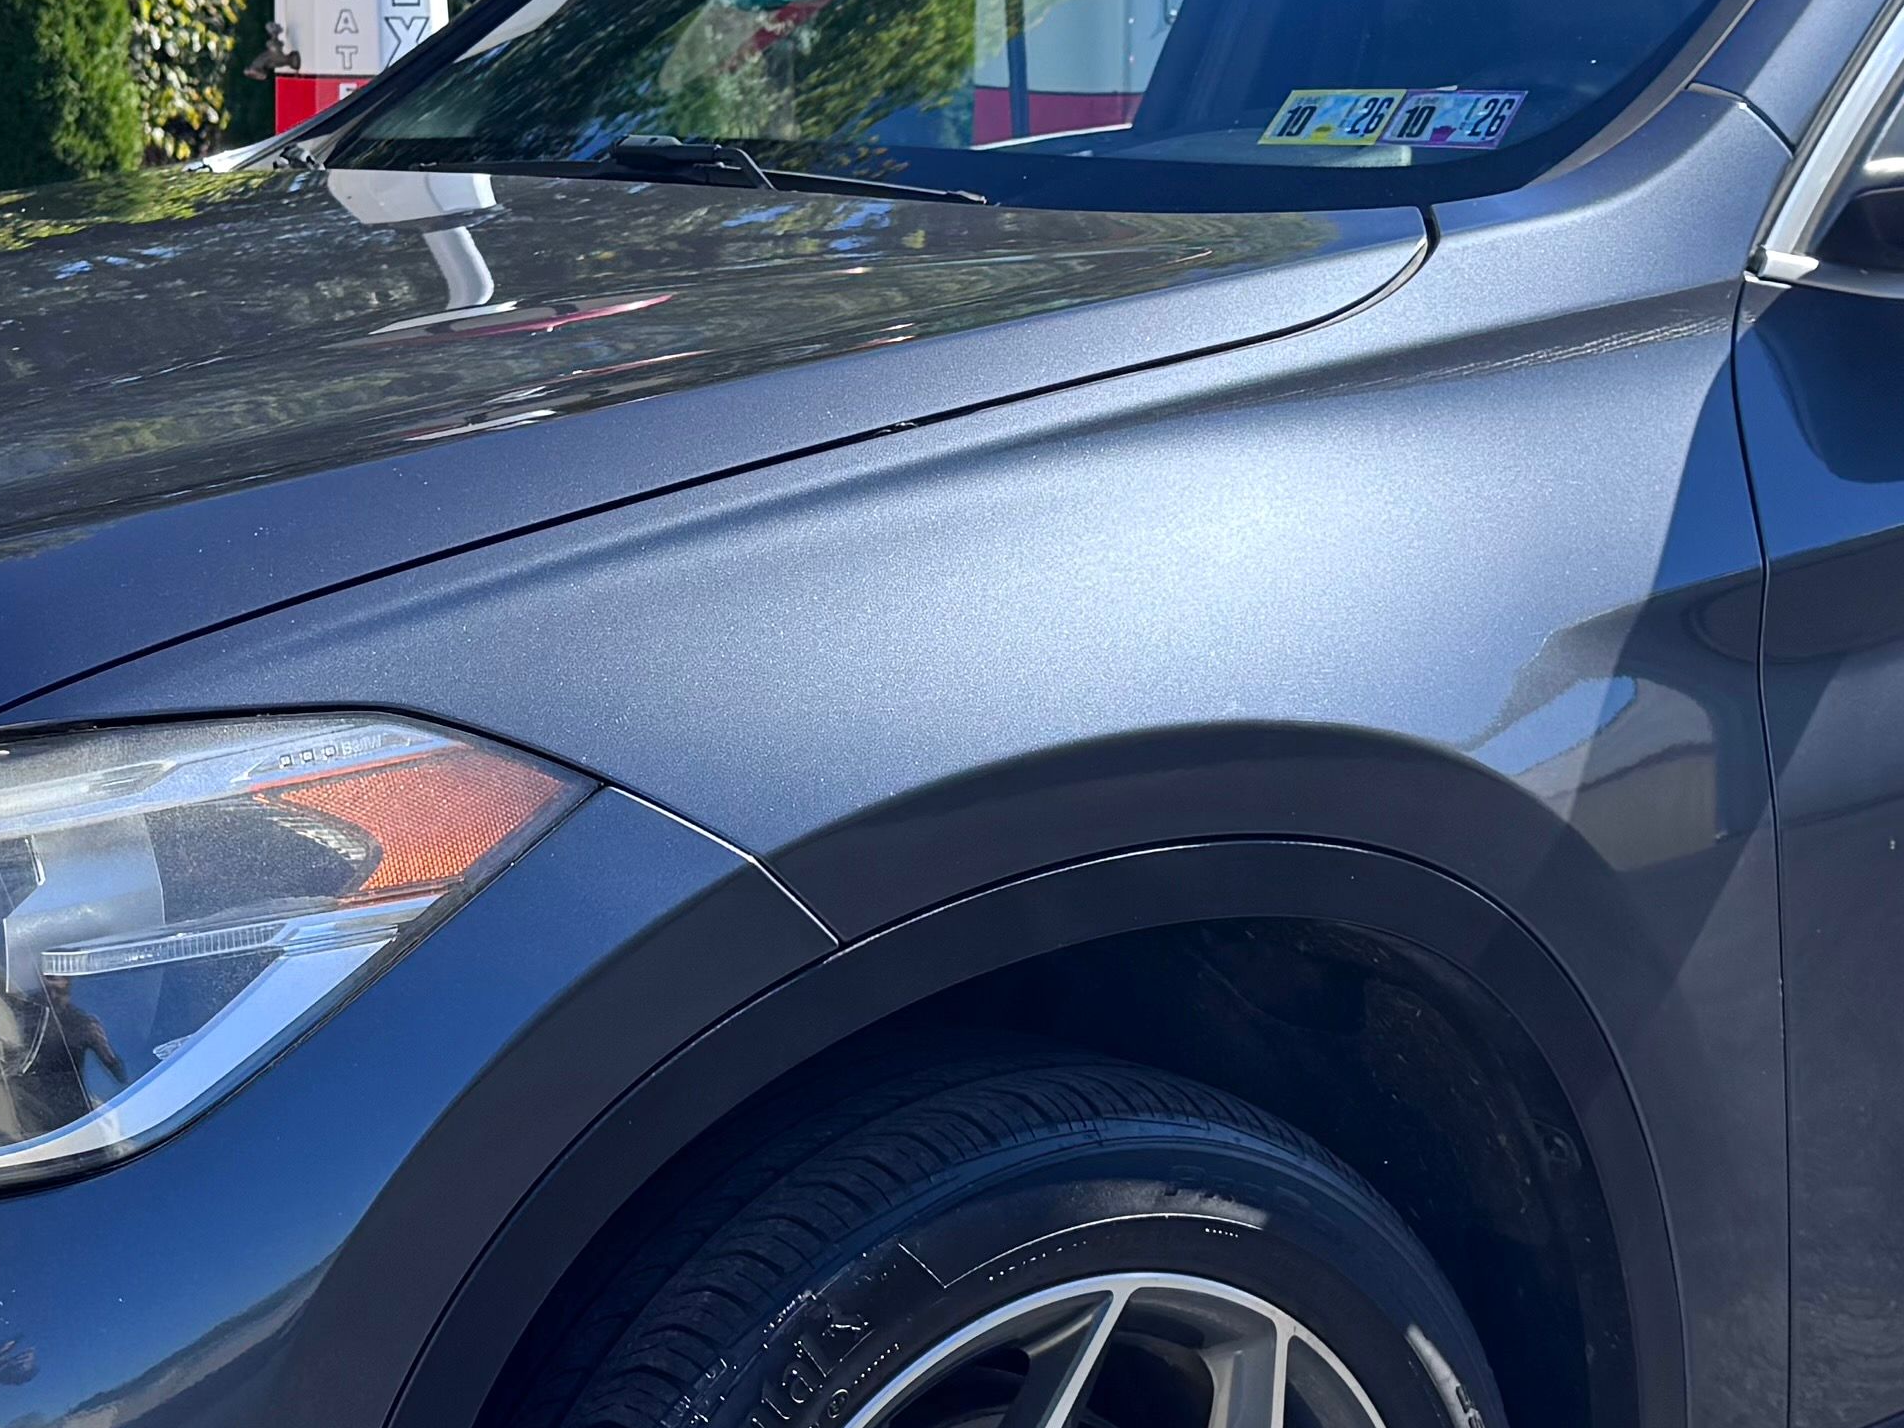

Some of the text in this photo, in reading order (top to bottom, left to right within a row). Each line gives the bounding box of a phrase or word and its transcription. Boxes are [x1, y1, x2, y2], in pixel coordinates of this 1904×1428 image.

[1277, 97, 1395, 137] 10 26
[1397, 98, 1516, 139] 10 26
